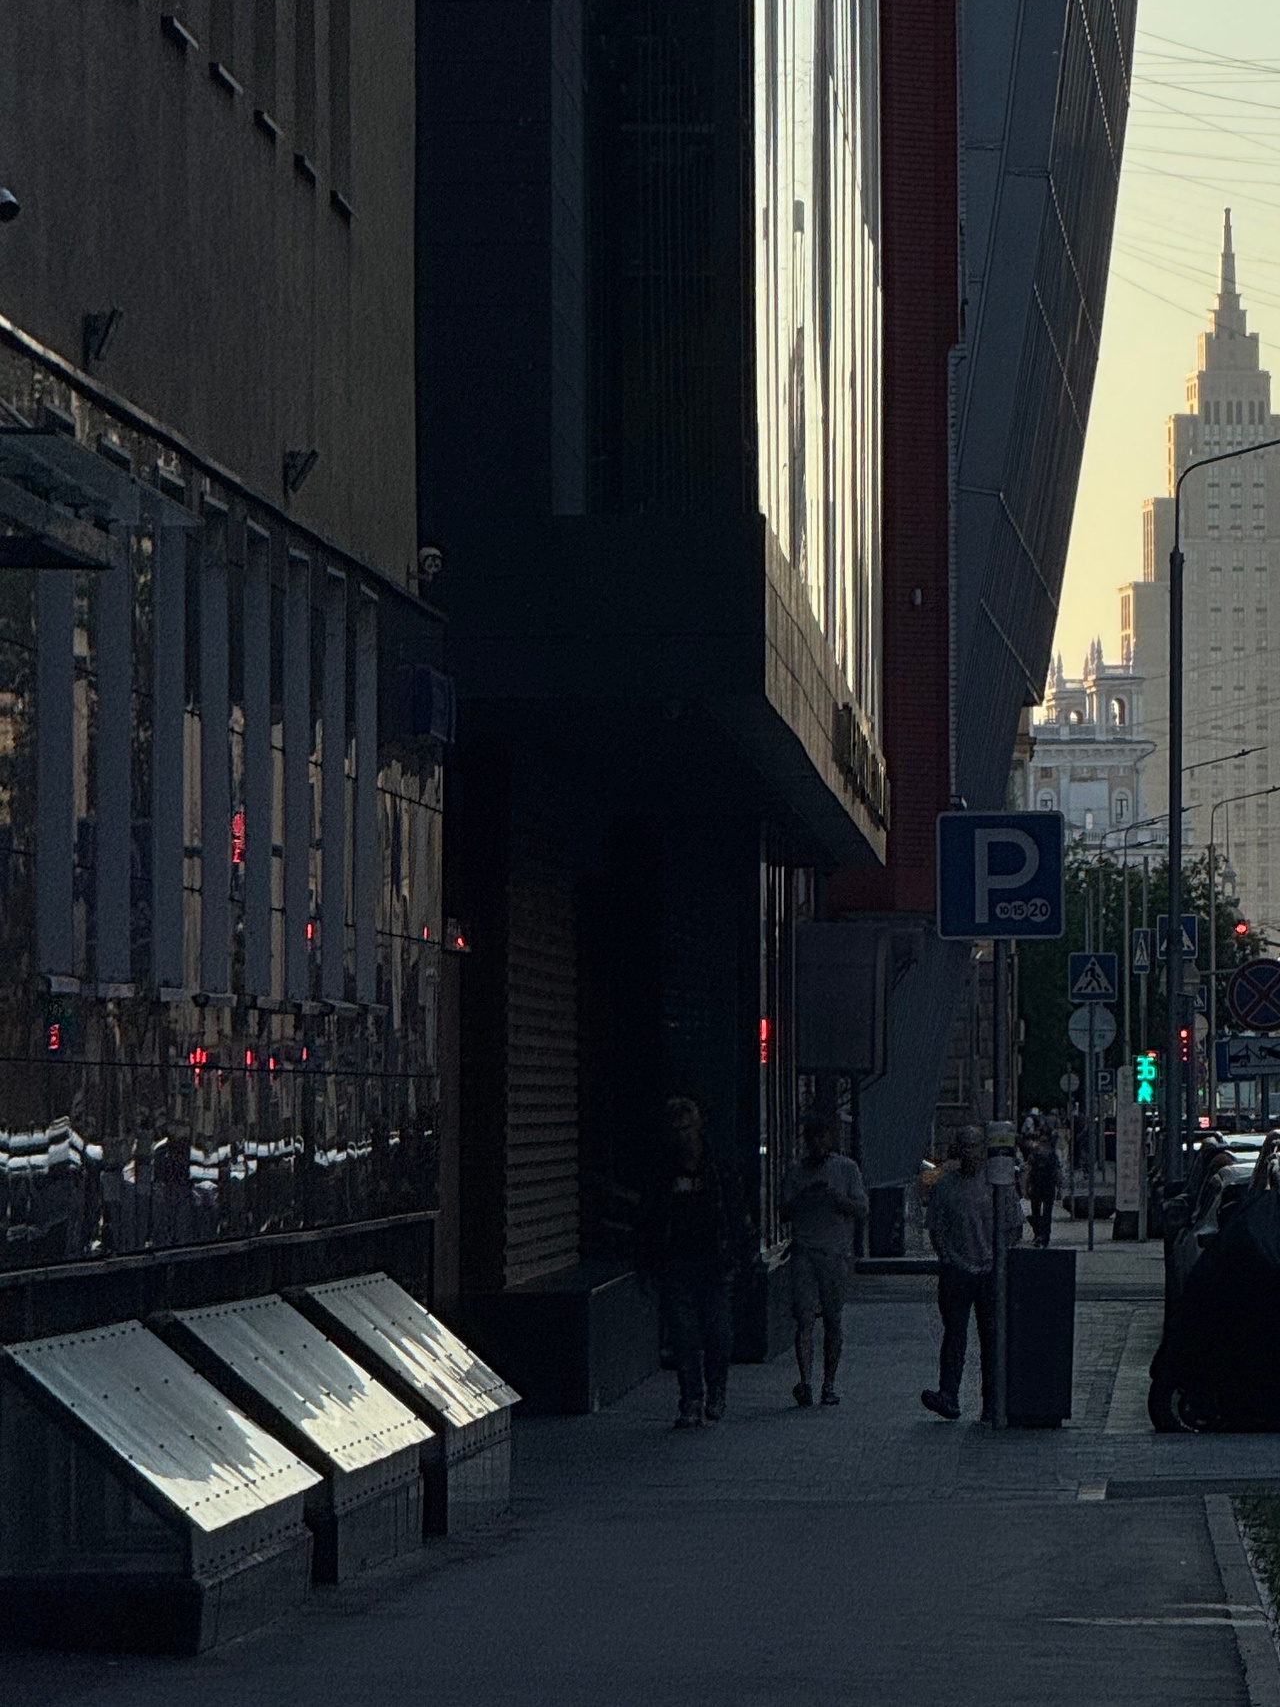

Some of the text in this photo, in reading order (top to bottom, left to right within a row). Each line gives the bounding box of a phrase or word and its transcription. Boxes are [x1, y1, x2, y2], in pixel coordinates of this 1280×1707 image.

[974, 827, 1040, 924] P
[1014, 905, 1025, 914] 15
[1029, 903, 1049, 917] 20
[1098, 1071, 1110, 1091] P
